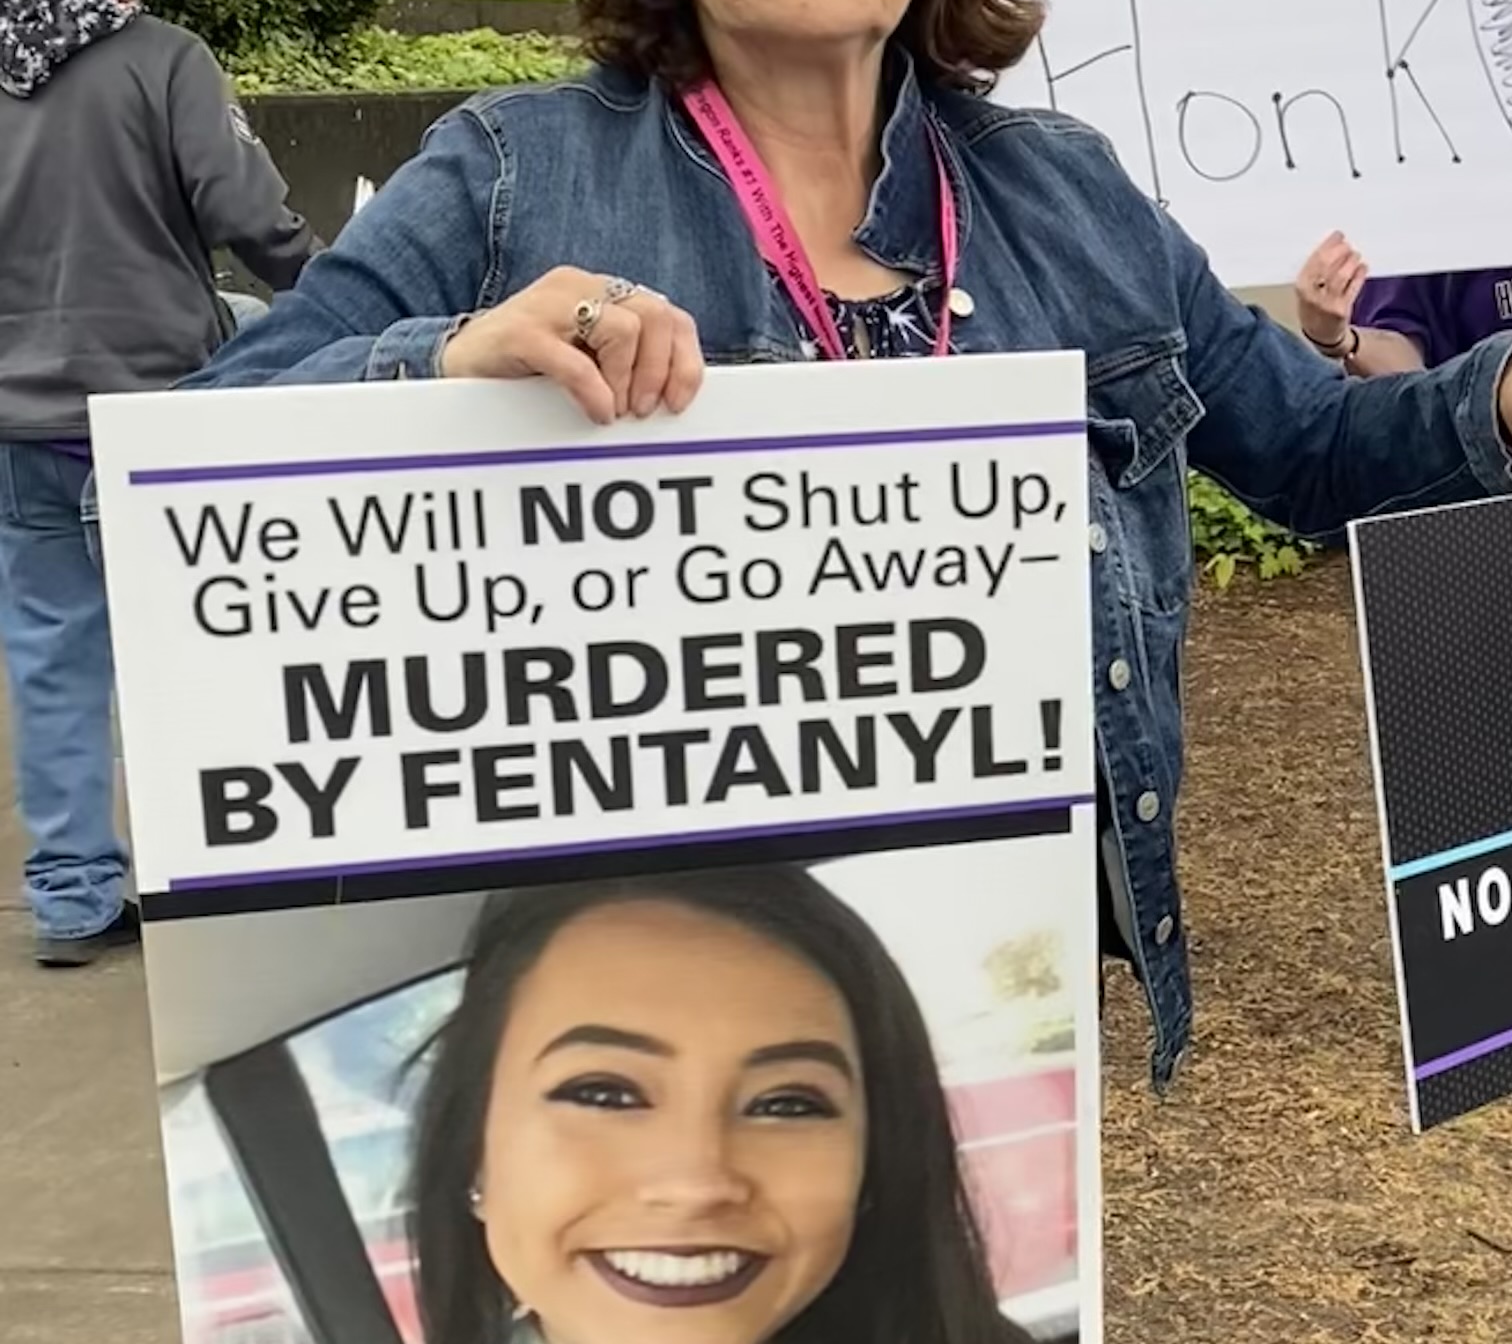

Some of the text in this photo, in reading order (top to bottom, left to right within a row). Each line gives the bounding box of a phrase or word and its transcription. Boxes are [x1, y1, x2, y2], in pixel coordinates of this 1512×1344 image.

[771, 223, 788, 251] The
[165, 460, 1066, 568] We Will NOT Shut Up,
[193, 574, 381, 638] Give
[416, 562, 544, 633] Up,
[572, 566, 649, 612] or
[676, 544, 783, 605] Go
[282, 616, 987, 743] MURDERED
[199, 698, 1062, 847] BY FENTANYL!
[1439, 867, 1511, 940] NO
